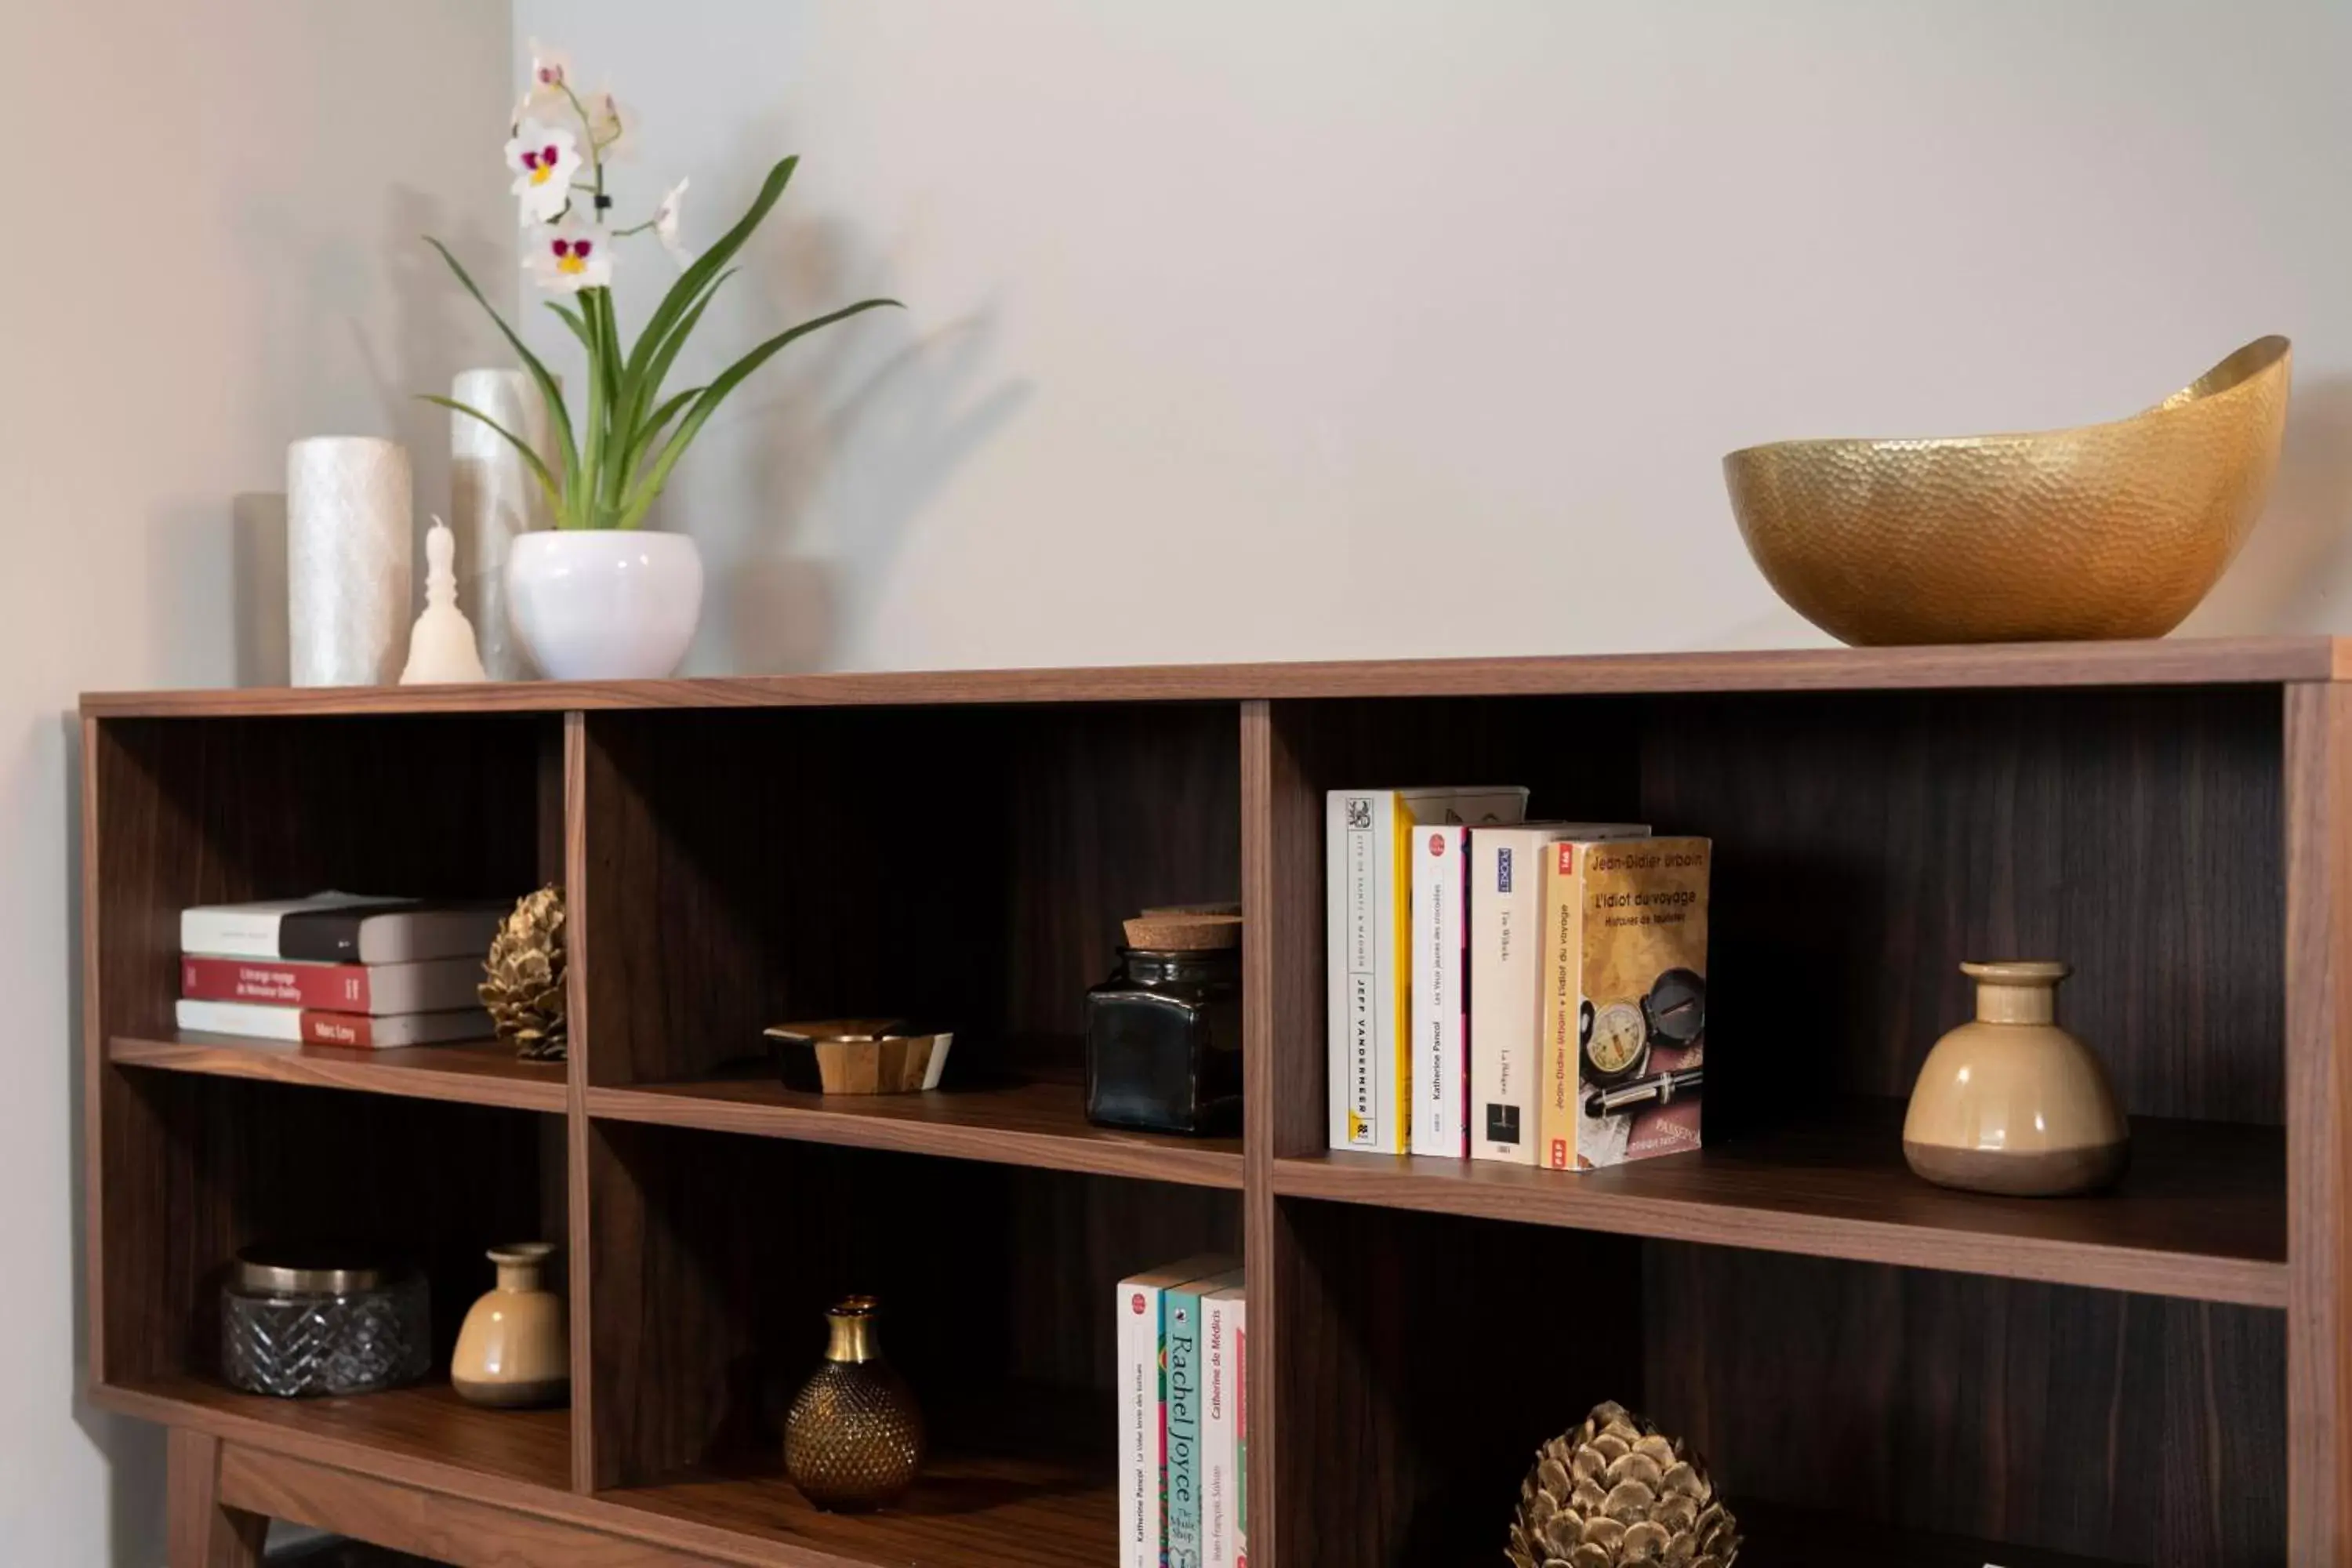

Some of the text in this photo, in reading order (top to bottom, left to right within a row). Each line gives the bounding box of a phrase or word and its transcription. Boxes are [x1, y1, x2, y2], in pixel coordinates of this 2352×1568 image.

[1498, 849, 1511, 892] POCKET
[1592, 853, 1661, 871] Jean-Didier
[1432, 884, 1441, 925] crocodiles
[1595, 891, 1697, 908] L'idiot du voyage
[1559, 904, 1570, 945] voyage
[1640, 913, 1650, 924] de
[1433, 942, 1443, 969] jaunes
[1558, 948, 1566, 963] du
[1556, 964, 1566, 997] L'idiot
[1357, 978, 1367, 1113] JEFF VANDERMEER
[1432, 1022, 1441, 1052] Pancol
[1432, 1054, 1441, 1101] Katherine
[1555, 1048, 1565, 1109] Jean-Didier
[1210, 1310, 1221, 1420] Catherine de Médicis
[1168, 1334, 1194, 1502] Rachel Joyce
[1136, 1453, 1144, 1463] La
[1135, 1470, 1144, 1499] Pancol
[1135, 1500, 1144, 1543] Katherine
